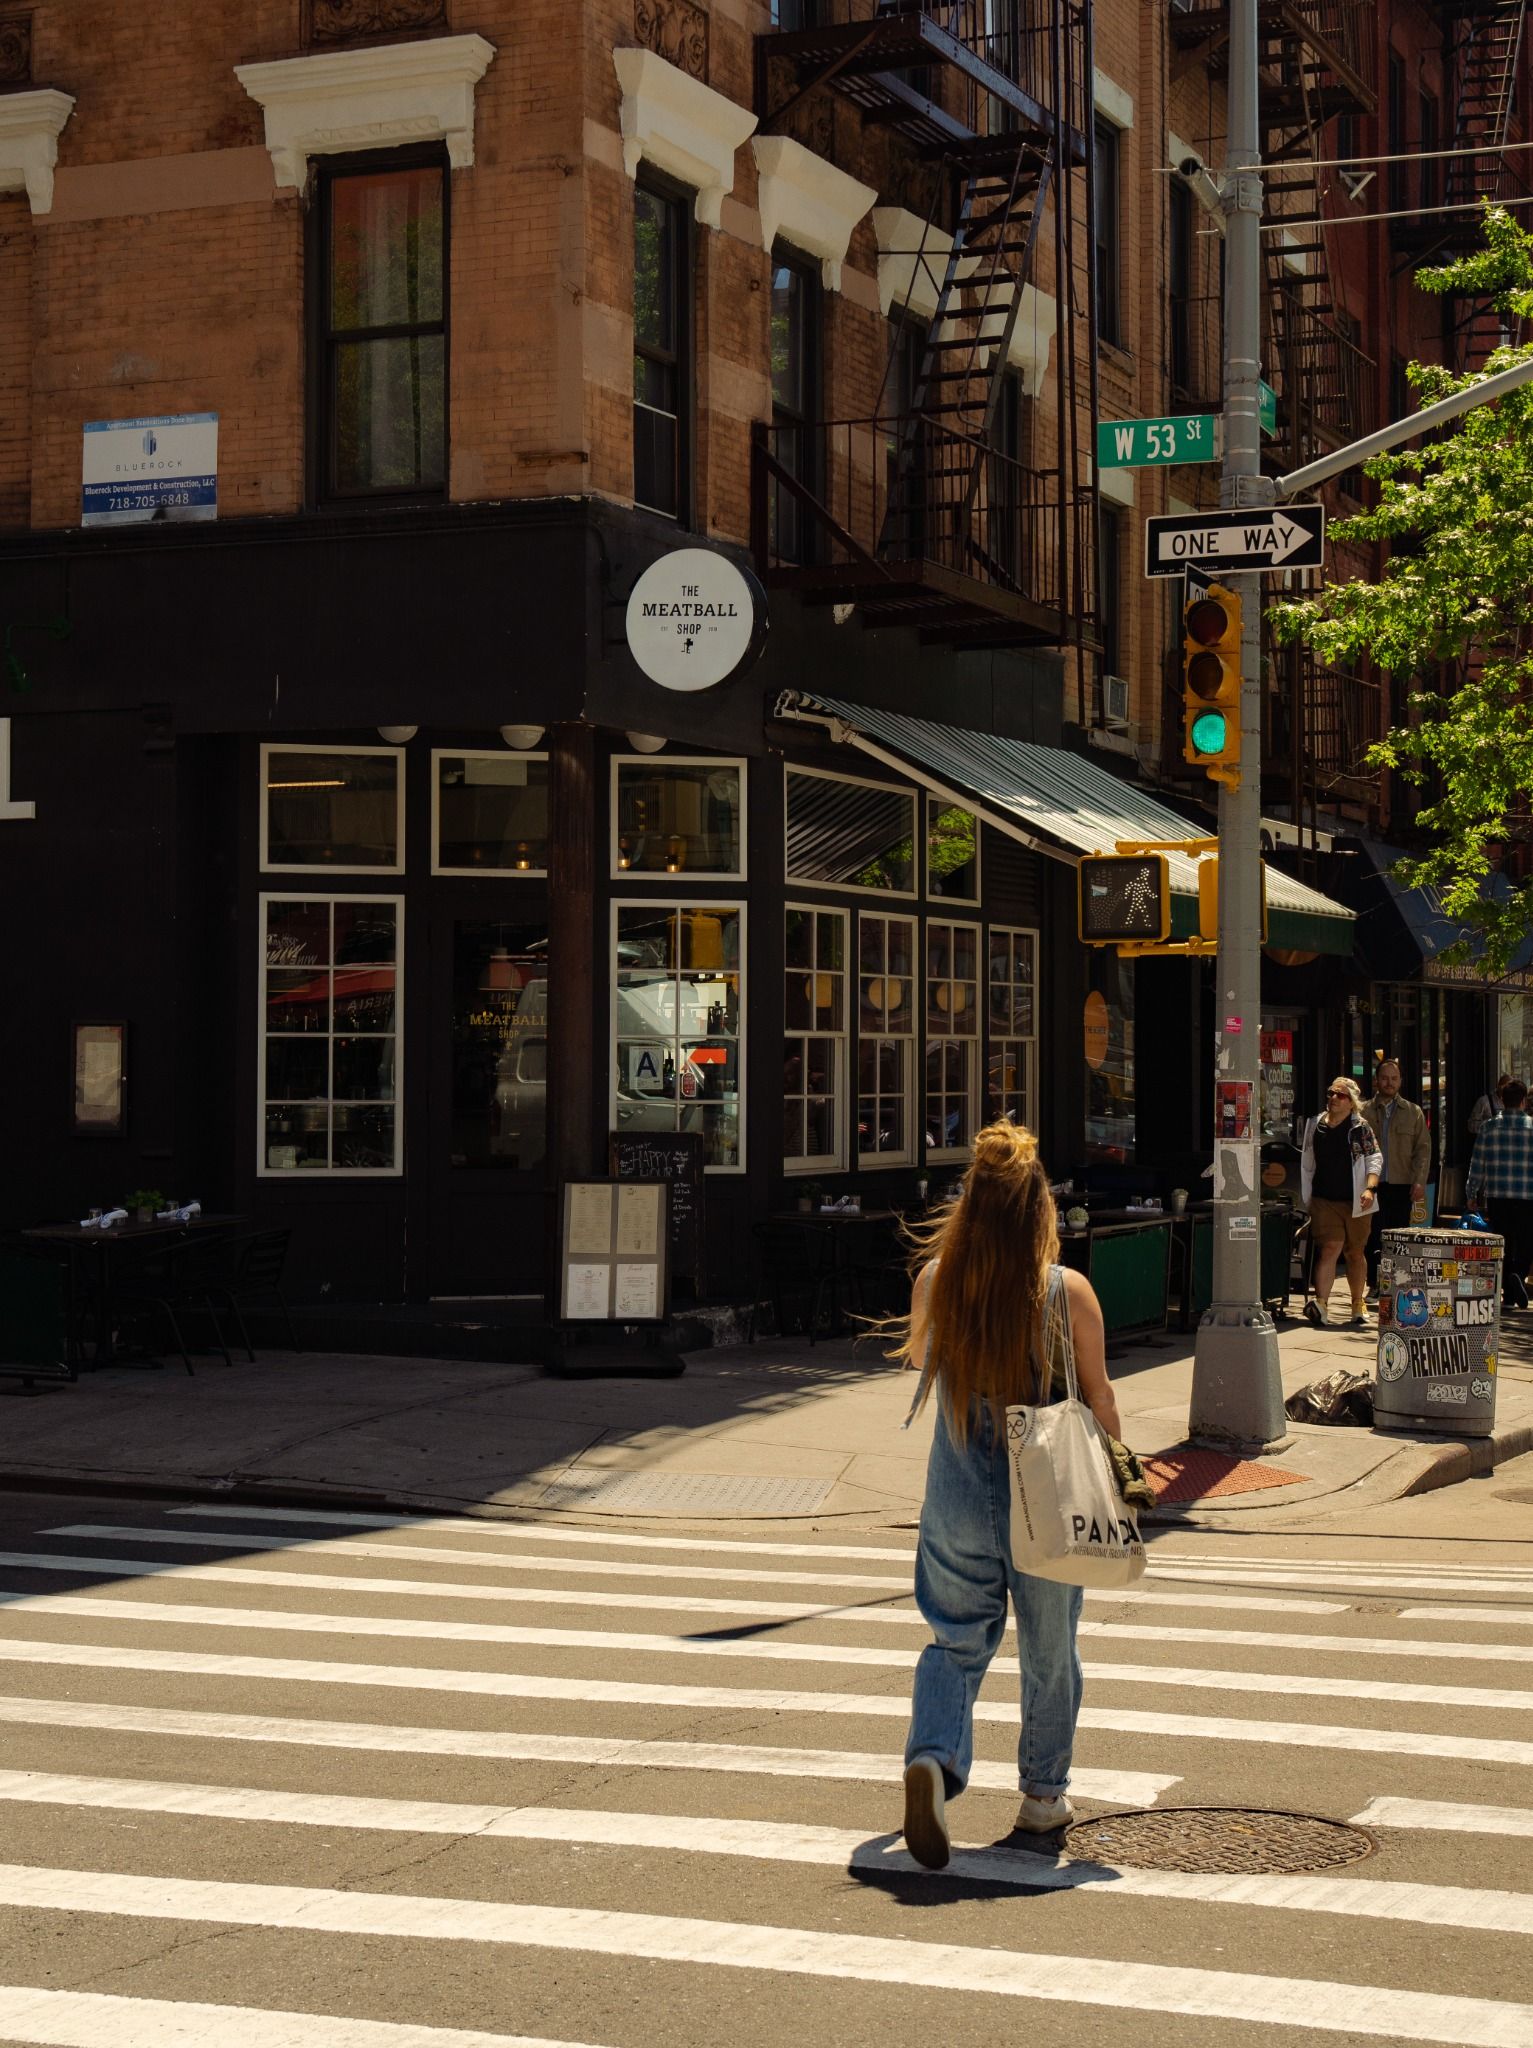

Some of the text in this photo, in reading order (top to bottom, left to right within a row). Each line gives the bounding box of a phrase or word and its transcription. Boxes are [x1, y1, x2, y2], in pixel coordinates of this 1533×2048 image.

[1115, 420, 1202, 460] W 53 St
[115, 461, 183, 472] BLUEROCK
[84, 486, 112, 495] Bluerock
[113, 483, 152, 493] Development
[153, 482, 159, 490] &
[202, 478, 215, 487] LLC
[108, 493, 189, 510] 718-705-6848
[1172, 527, 1295, 556] ONE WAY
[681, 585, 699, 597] THE
[642, 603, 738, 617] MEATBALL
[677, 624, 702, 635] SHOP
[501, 1001, 517, 1011] THE
[469, 1014, 547, 1025] MEATBALL
[498, 1029, 519, 1039] SHOP
[1271, 1048, 1288, 1063] WARM
[637, 1051, 657, 1078] A
[1268, 1069, 1292, 1084] COOKIES
[632, 1150, 671, 1170] HAPPY
[1425, 1236, 1473, 1246] Don't litter
[1409, 1334, 1469, 1378] REMAND
[1072, 1514, 1140, 1545] PANDA
